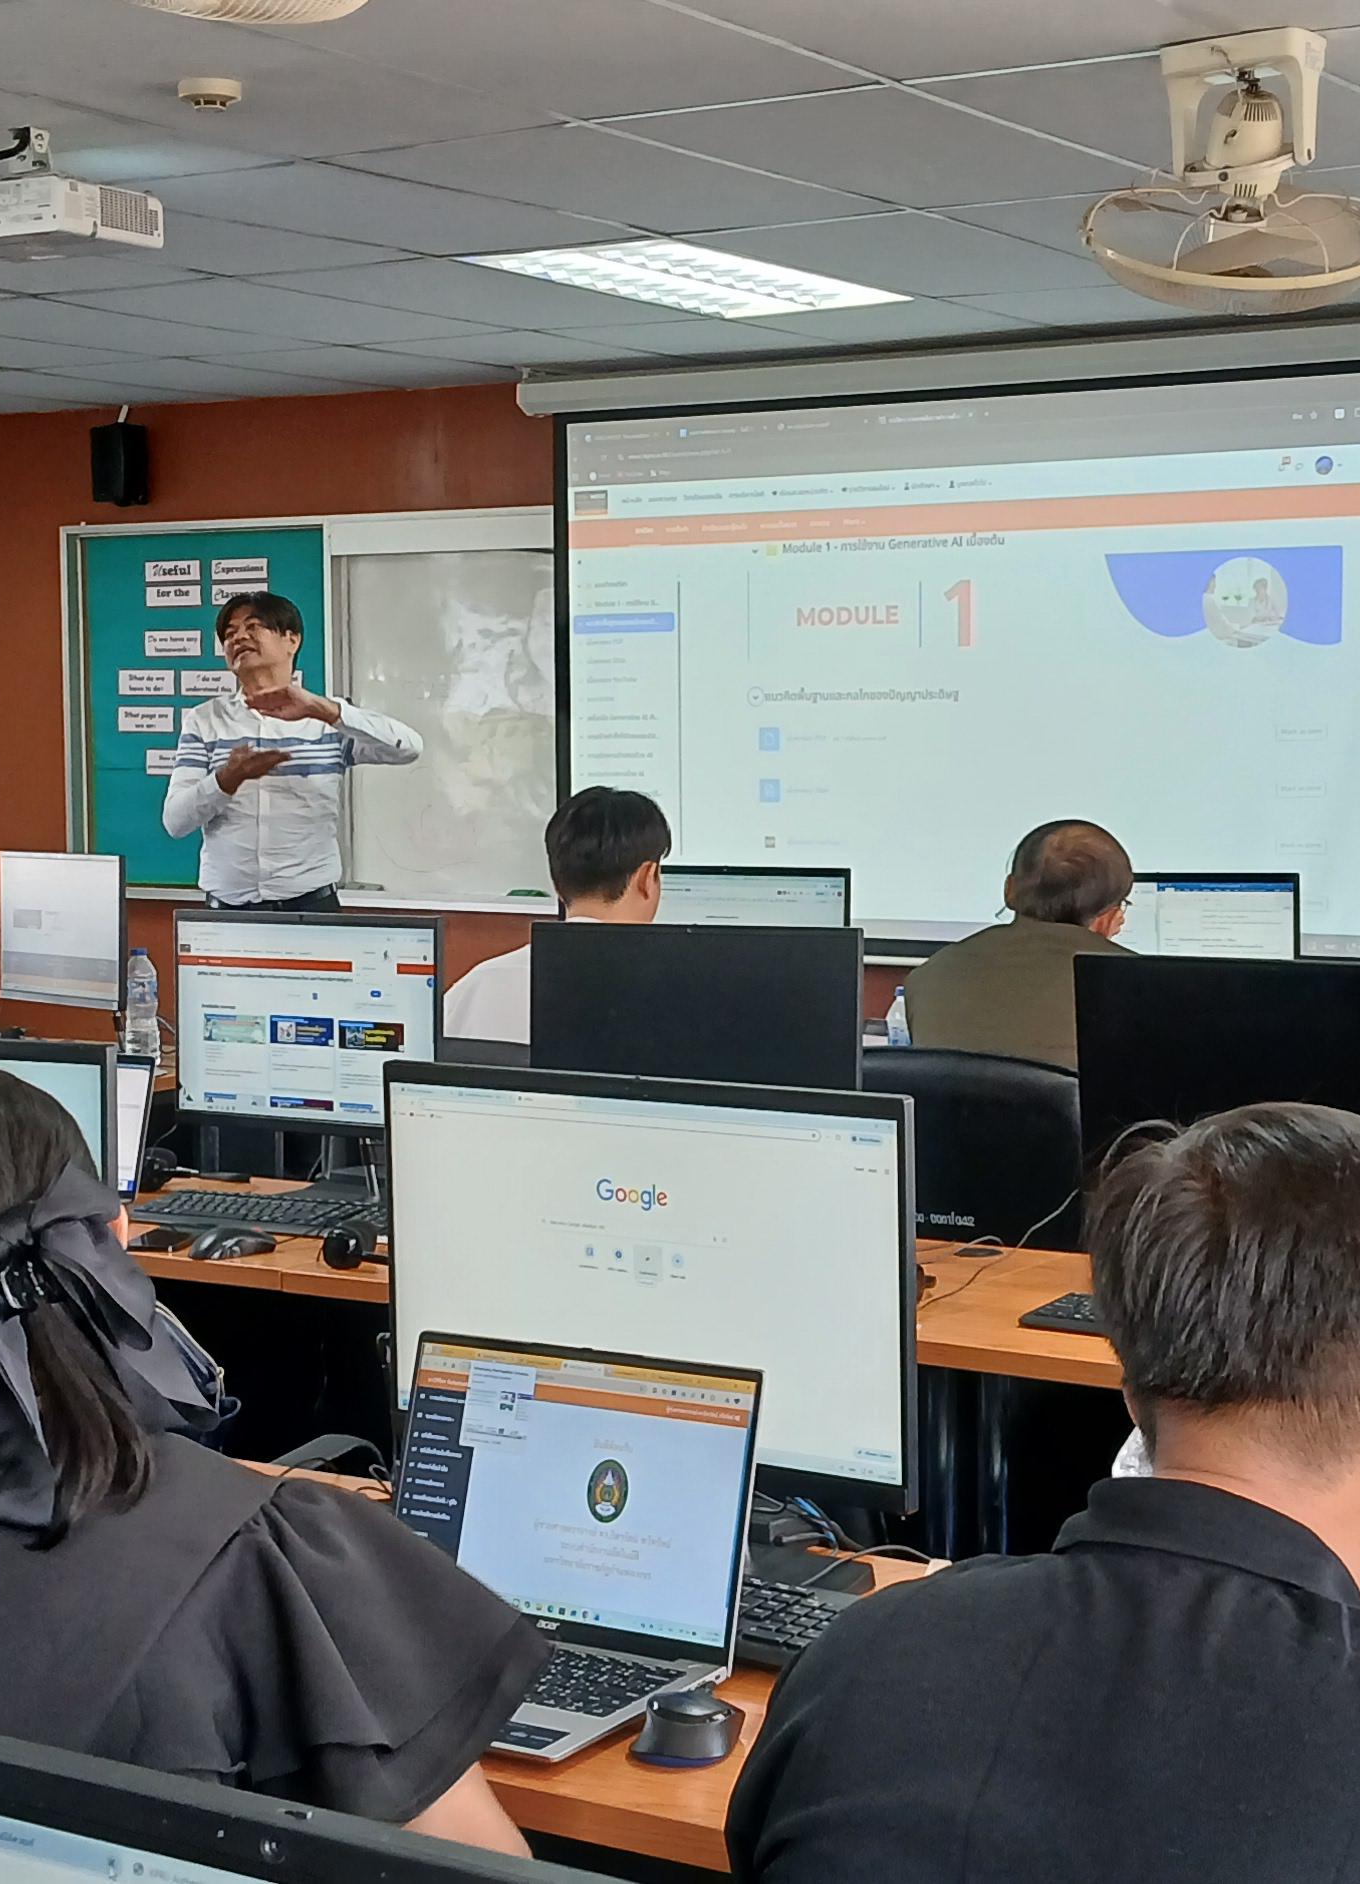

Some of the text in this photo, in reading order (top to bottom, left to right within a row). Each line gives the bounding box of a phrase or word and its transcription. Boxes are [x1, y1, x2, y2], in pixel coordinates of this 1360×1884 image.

[782, 542, 822, 555] Module
[889, 536, 948, 550] Generative
[152, 562, 191, 577] Useful
[214, 562, 264, 575] Expressions
[156, 588, 190, 598] for the
[796, 579, 971, 647] MODULE 1
[596, 1178, 668, 1211] Google
[536, 1619, 561, 1631] acer
